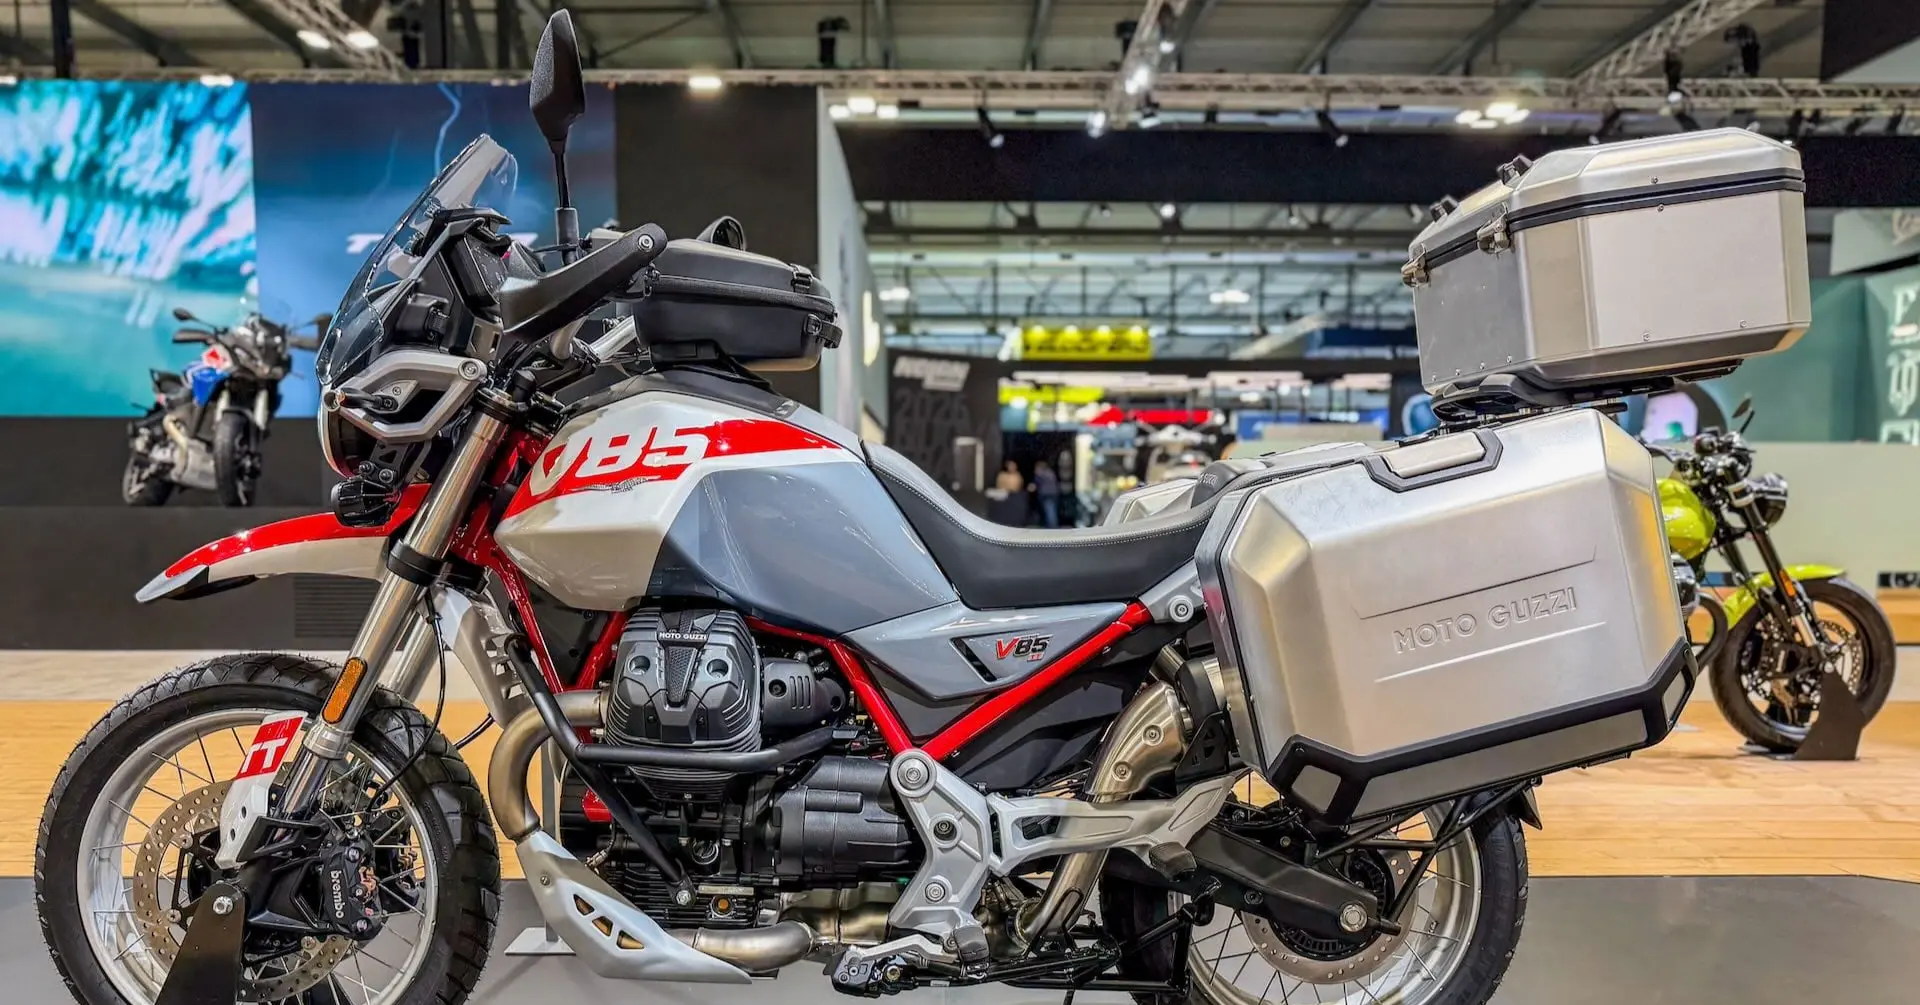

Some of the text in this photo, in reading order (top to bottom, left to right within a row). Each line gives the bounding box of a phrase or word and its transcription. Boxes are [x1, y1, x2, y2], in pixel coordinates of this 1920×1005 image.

[530, 423, 710, 497] V85
[659, 631, 707, 641] MOTO GUZZI
[1393, 586, 1578, 654] MOTO GUZZI
[996, 633, 1053, 660] V85
[330, 869, 346, 919] brembo
